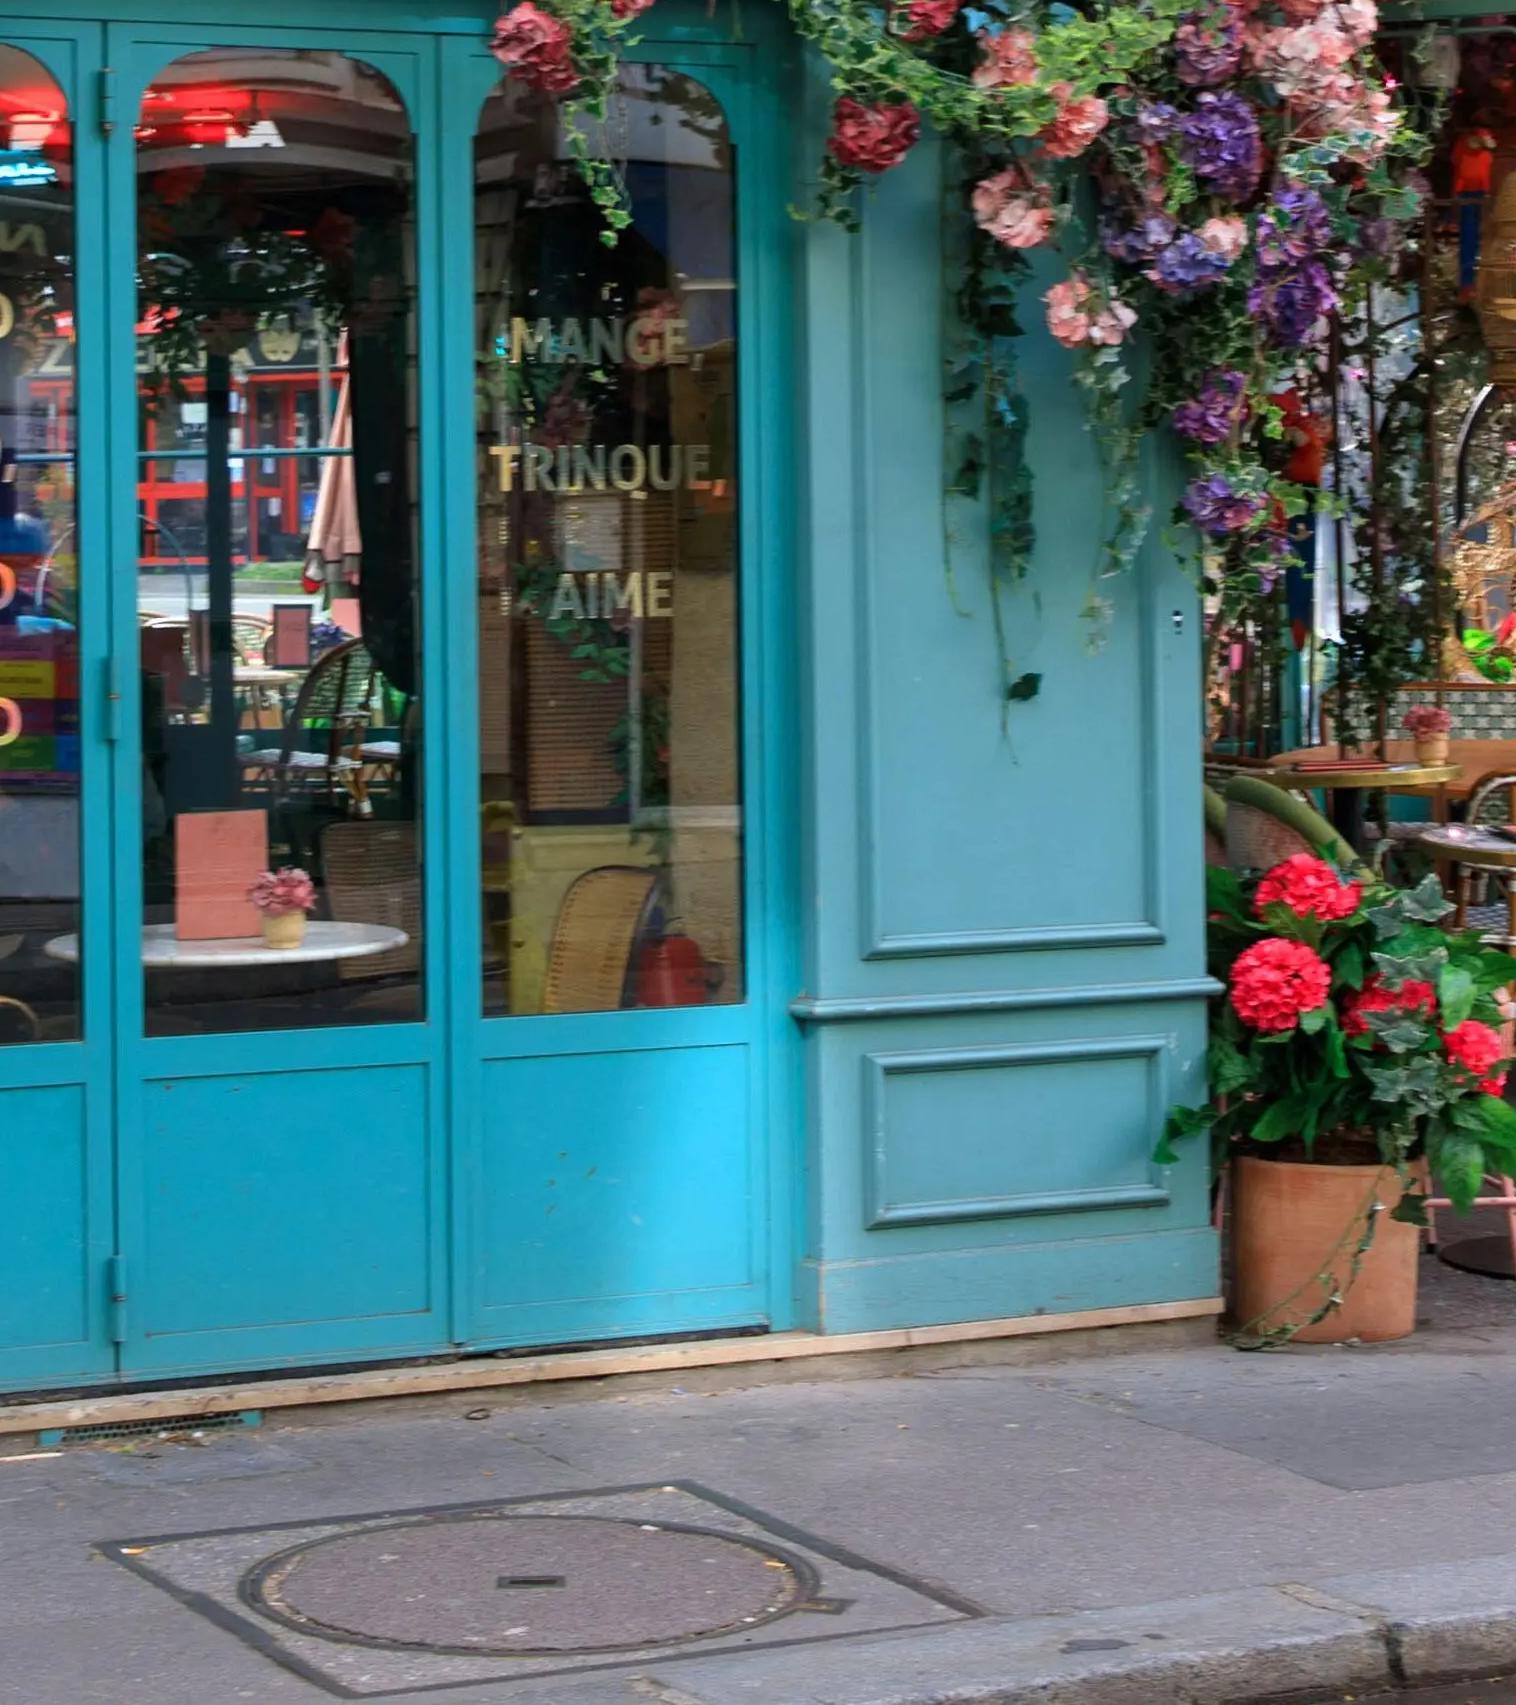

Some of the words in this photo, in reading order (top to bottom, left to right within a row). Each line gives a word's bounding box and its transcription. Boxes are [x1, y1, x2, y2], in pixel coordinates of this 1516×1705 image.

[509, 316, 704, 371] MANGE,
[488, 444, 727, 500] TRINQUE,
[548, 571, 675, 620] AIME
